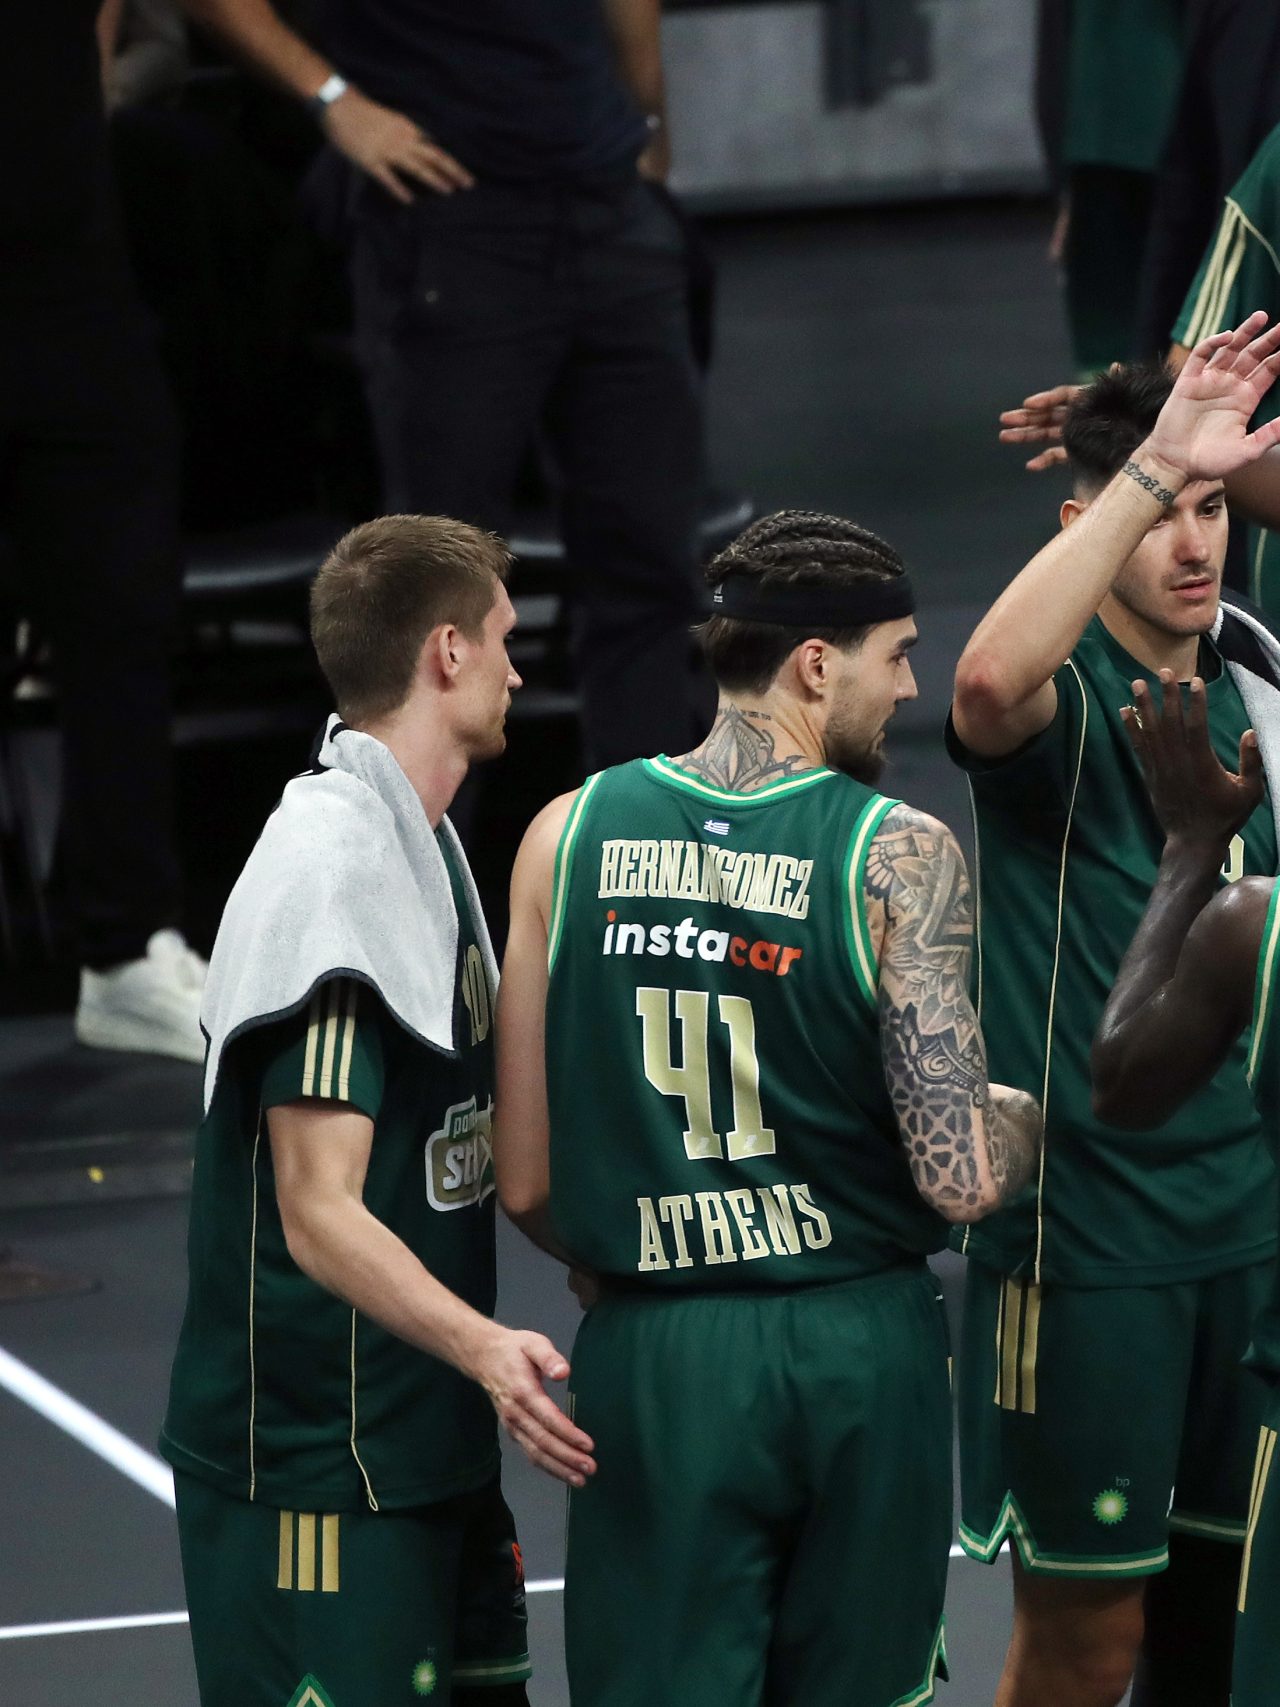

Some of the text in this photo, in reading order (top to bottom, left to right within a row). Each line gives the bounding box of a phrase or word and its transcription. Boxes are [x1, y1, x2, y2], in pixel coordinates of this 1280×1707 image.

[597, 838, 815, 920] HERNANGOMEZ
[603, 909, 803, 977] instacar
[636, 986, 776, 1162] 41
[636, 1183, 833, 1272] ATHENS
